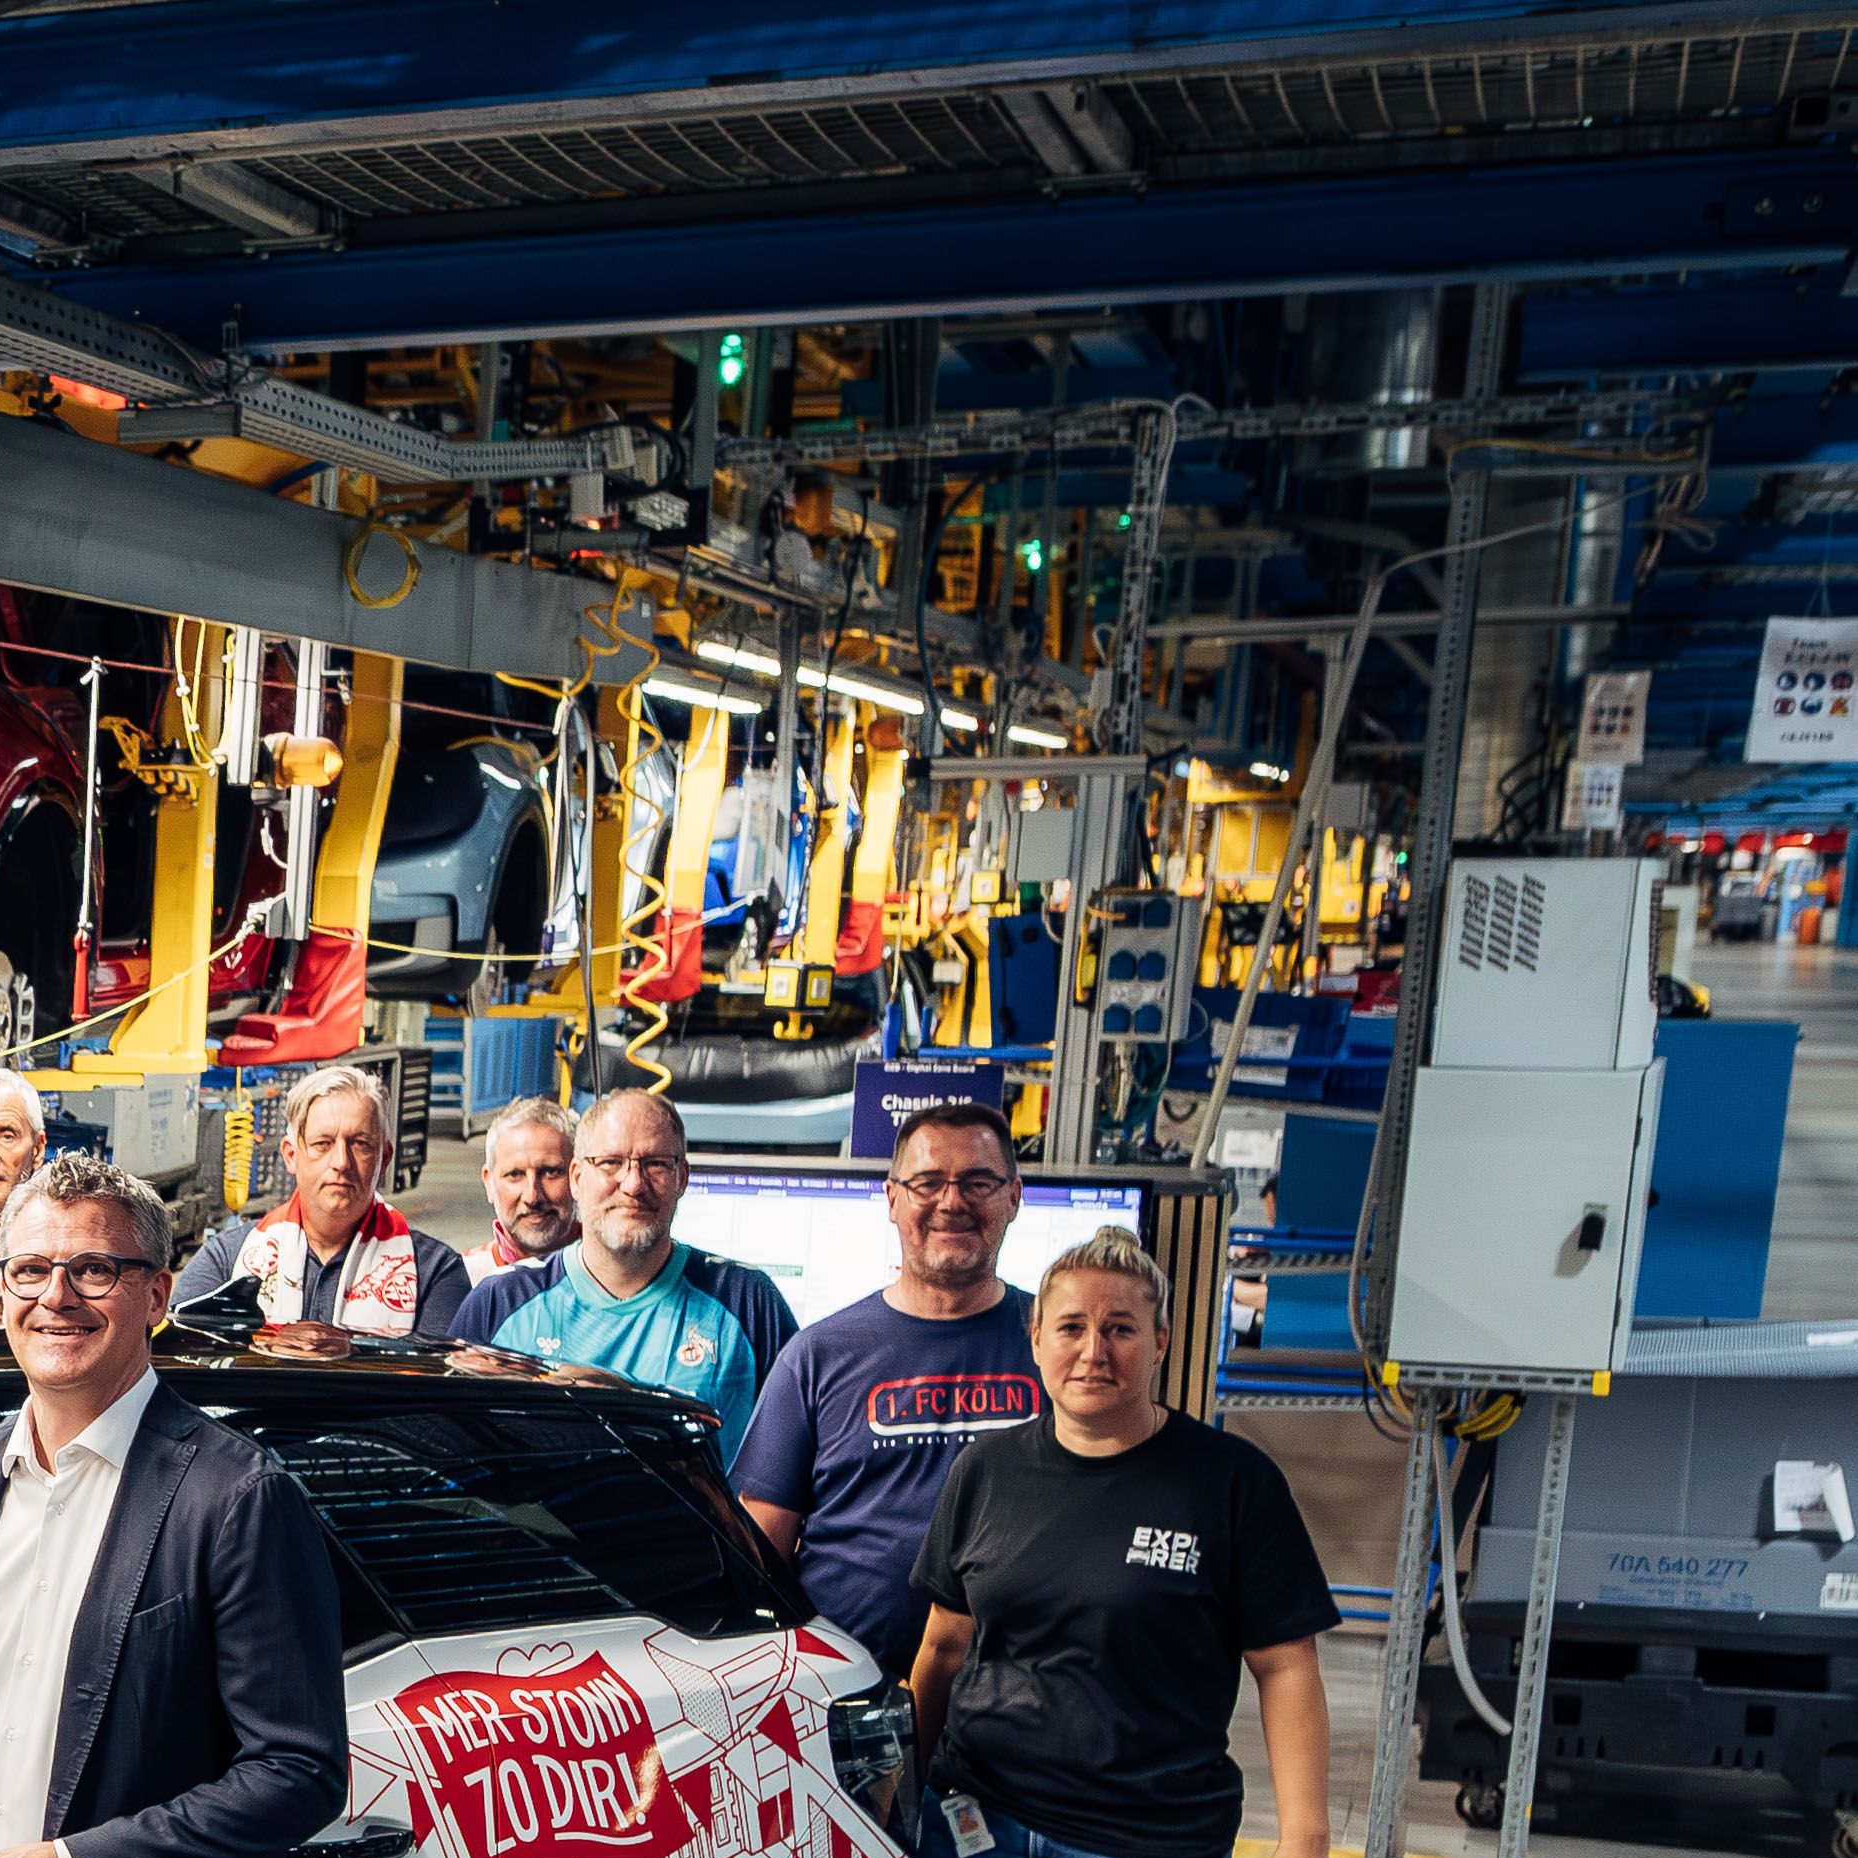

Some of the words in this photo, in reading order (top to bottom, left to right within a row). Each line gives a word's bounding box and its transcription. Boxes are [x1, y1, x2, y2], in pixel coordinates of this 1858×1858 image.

[915, 1388, 946, 1415] FC
[954, 1381, 1023, 1414] KÖLN
[416, 1687, 517, 1764] MER
[510, 1670, 642, 1750] STONN
[463, 1761, 538, 1857] ZO
[537, 1750, 648, 1830] DIR!
